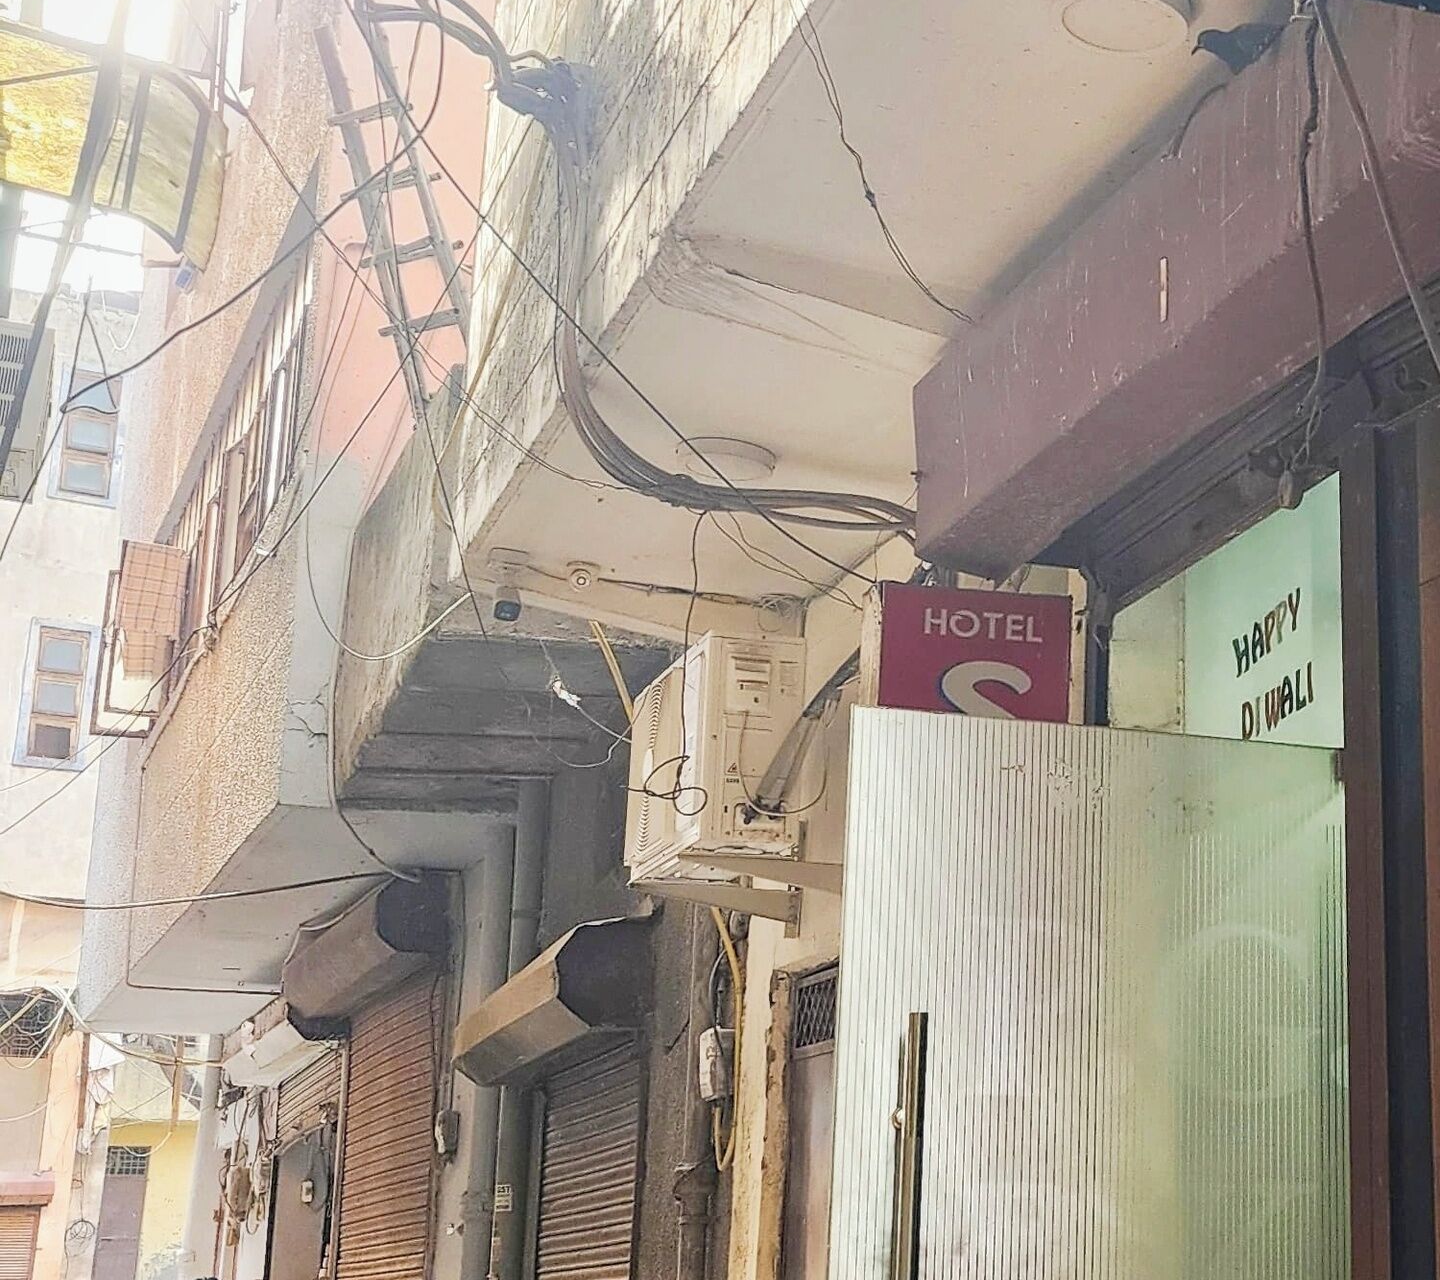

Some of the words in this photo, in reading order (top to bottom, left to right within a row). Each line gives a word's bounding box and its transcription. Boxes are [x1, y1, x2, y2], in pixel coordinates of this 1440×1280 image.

[923, 606, 1043, 644] HOTEL
[1232, 587, 1301, 679] HAPPY
[1241, 661, 1314, 741] DIWALI
